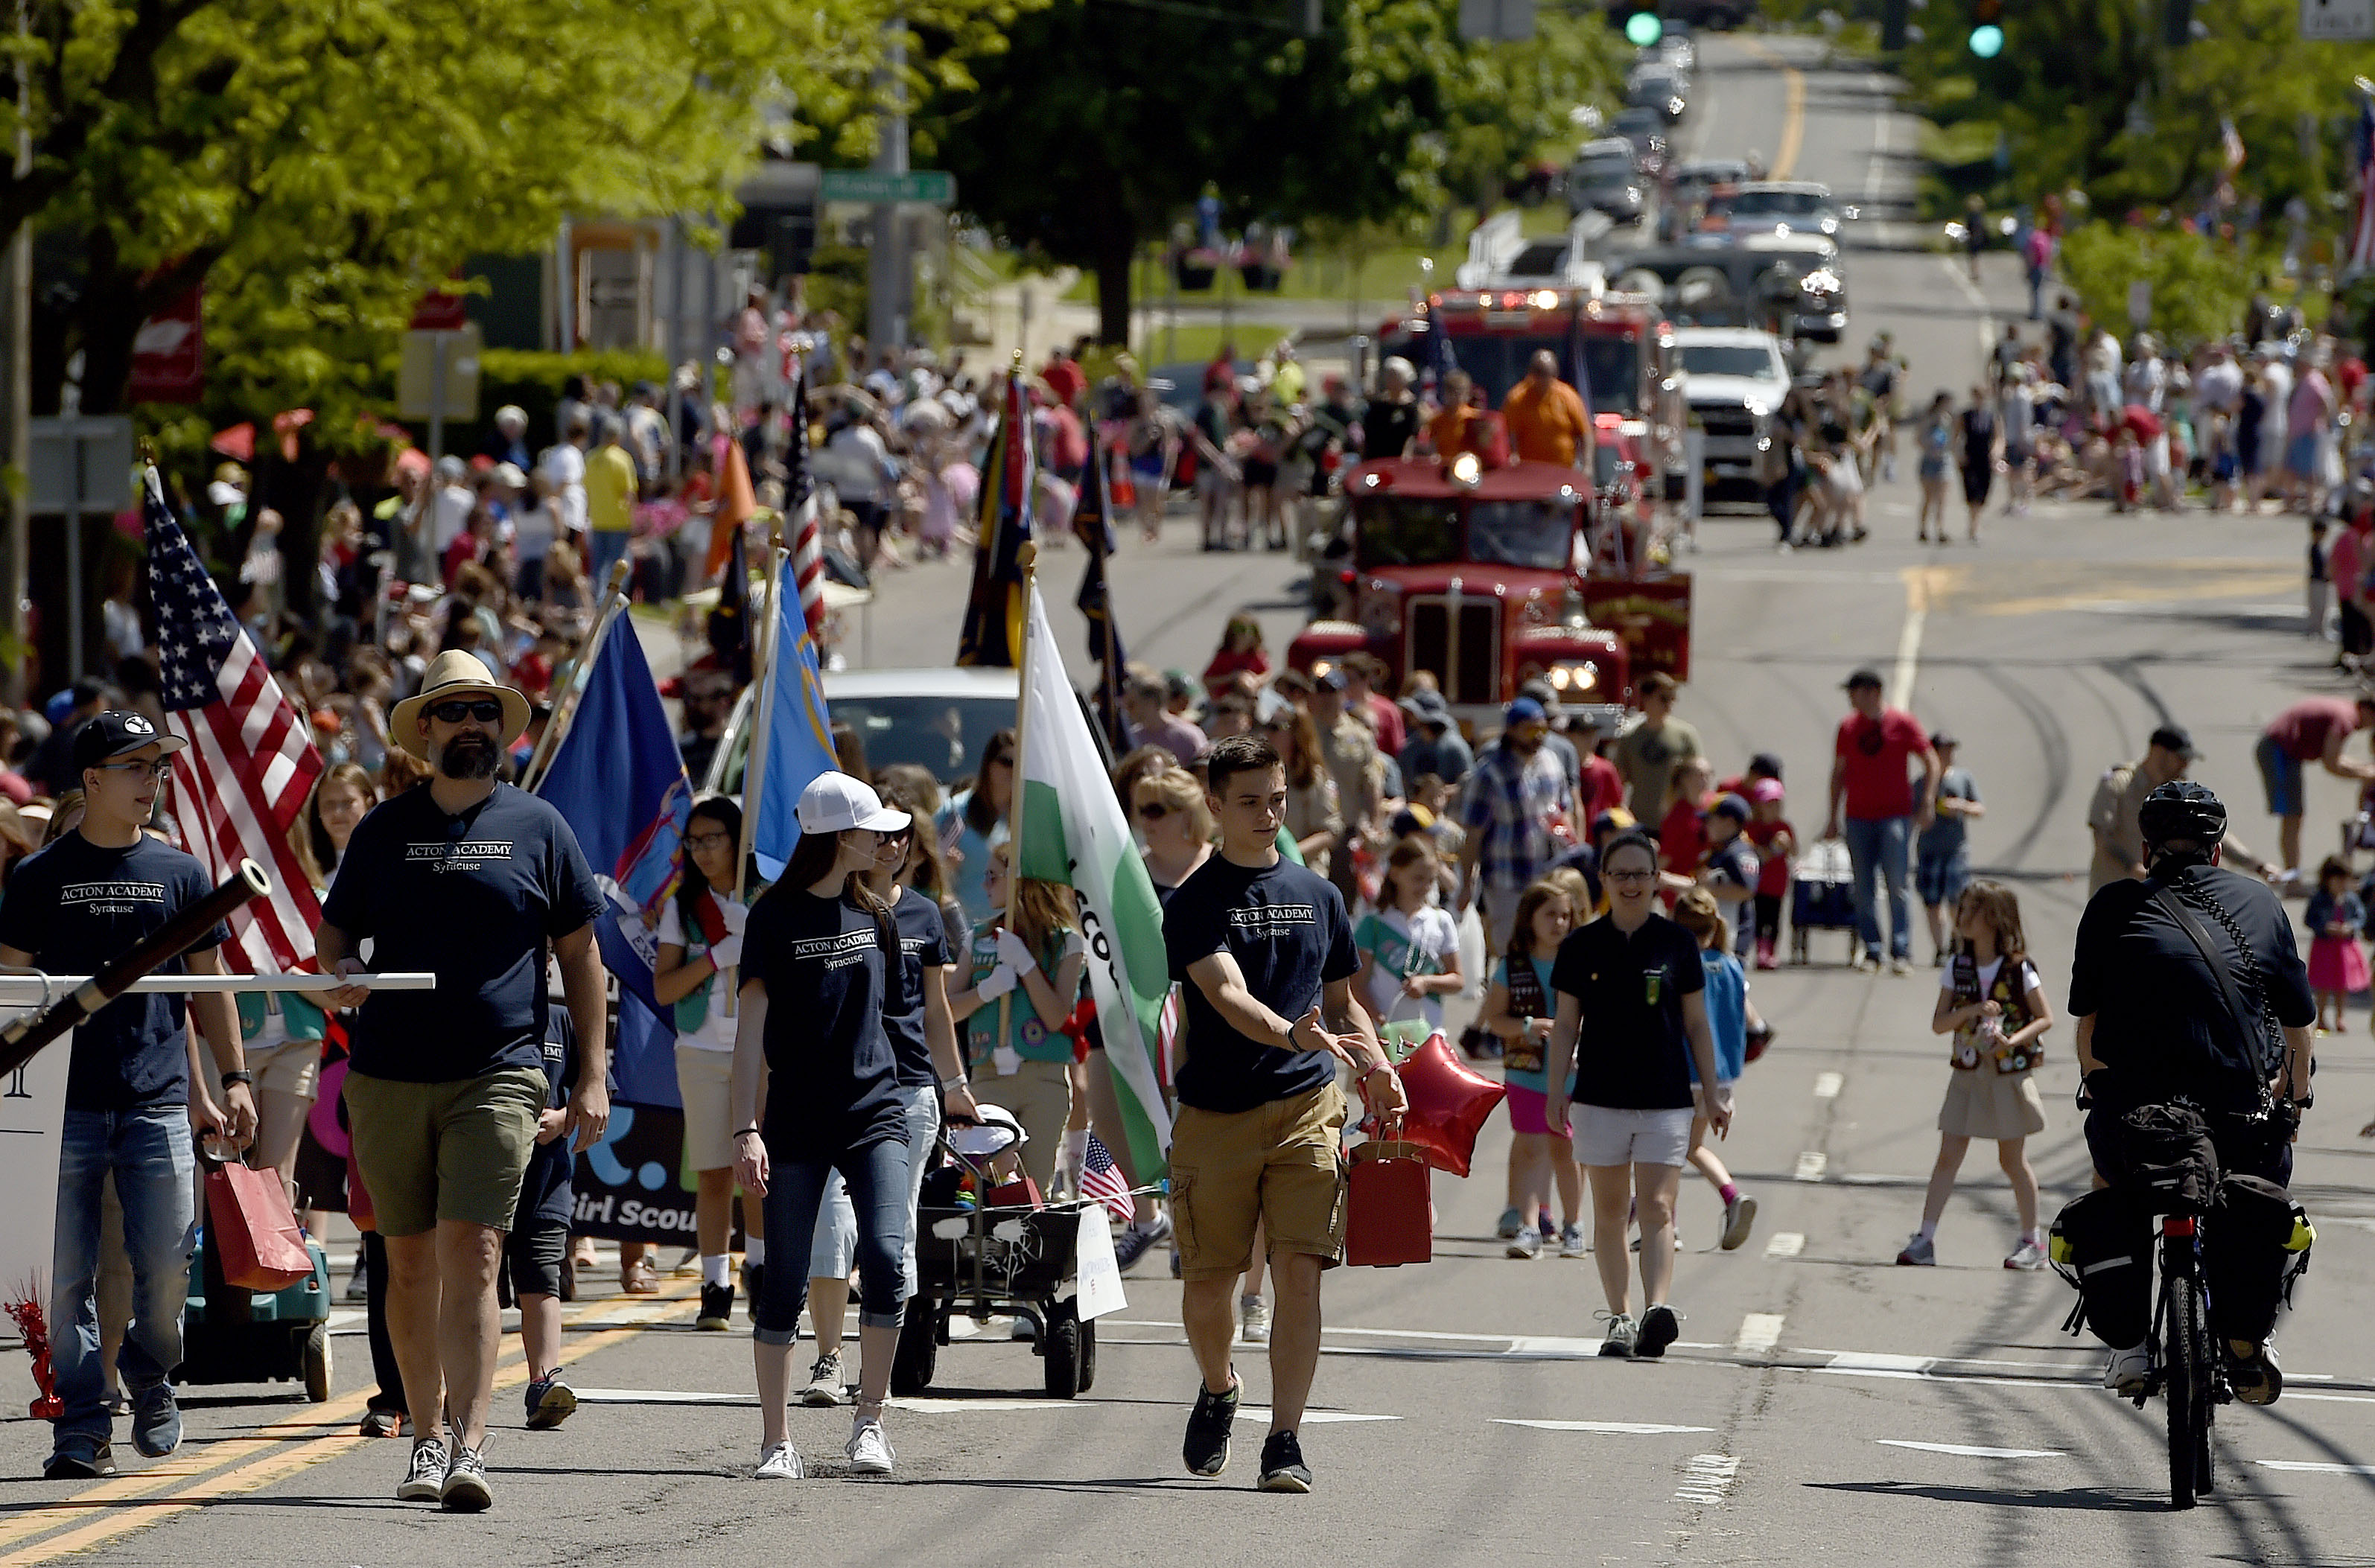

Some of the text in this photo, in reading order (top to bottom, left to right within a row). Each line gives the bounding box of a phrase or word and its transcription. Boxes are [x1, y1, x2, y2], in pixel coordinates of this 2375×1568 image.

[406, 845, 512, 856] ACTON ACADEMY
[432, 861, 481, 873] Syracuse
[61, 886, 164, 900] ACTON ACADEMY
[89, 903, 134, 915] Syracuse
[1230, 908, 1313, 923] ACTON ACADEMY
[795, 932, 876, 954] ACTON ACADEMY
[824, 954, 864, 971] Syracuse
[617, 1199, 698, 1233] Scou
